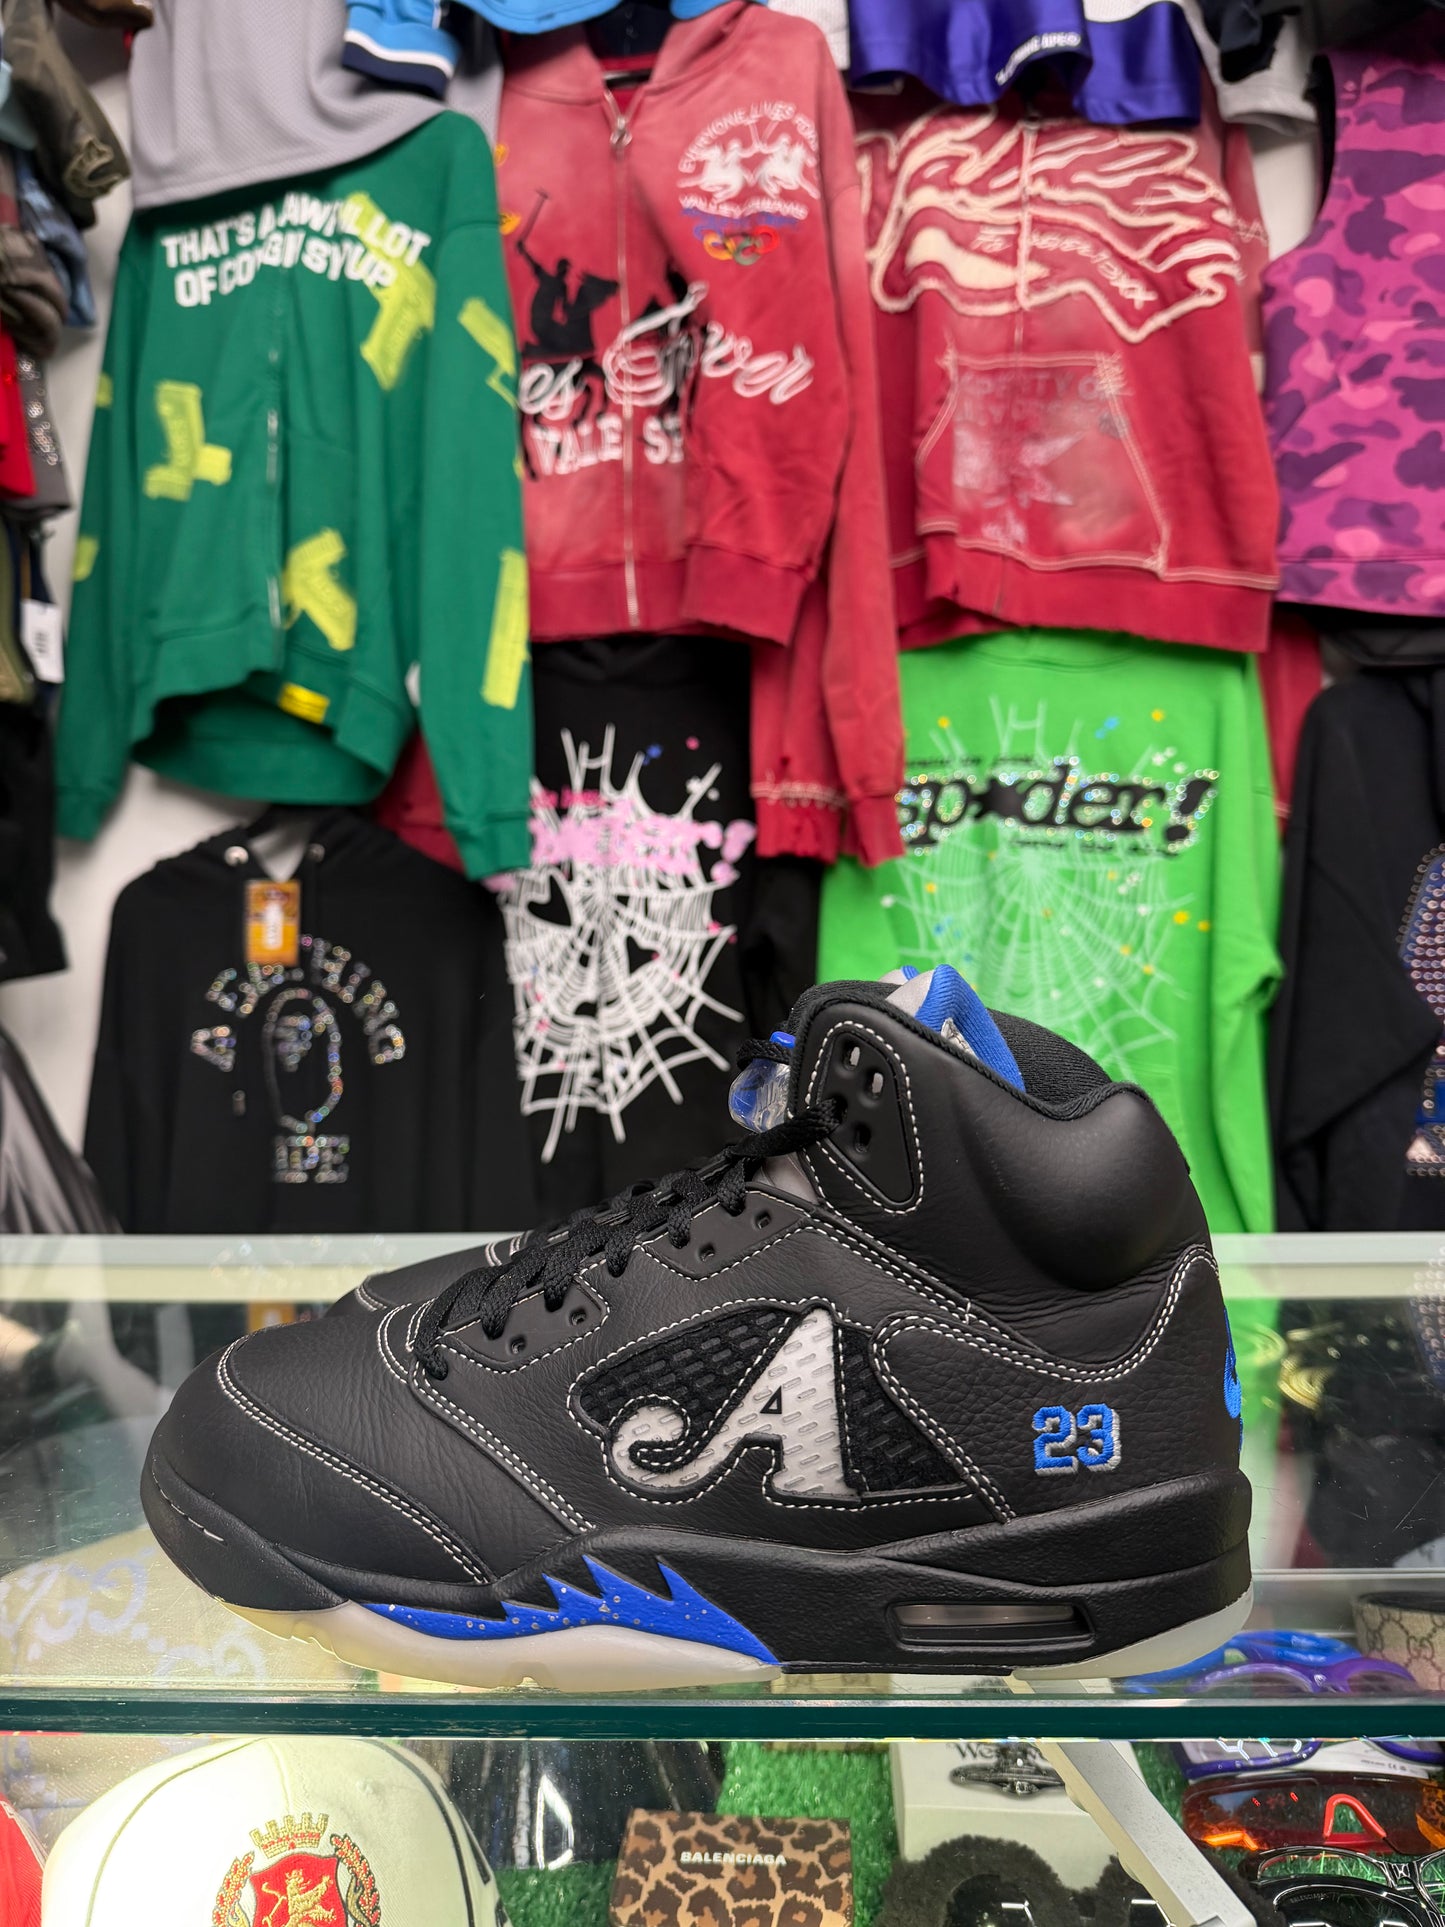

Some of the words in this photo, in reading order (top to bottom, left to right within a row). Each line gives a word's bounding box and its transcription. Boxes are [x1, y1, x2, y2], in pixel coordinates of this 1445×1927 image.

[161, 211, 256, 268] THAT'S
[257, 203, 277, 240] A
[363, 213, 432, 267] LOT
[174, 265, 218, 307] OF
[1031, 1403, 1122, 1476] 23
[681, 1851, 787, 1866] BALENCIAGA
